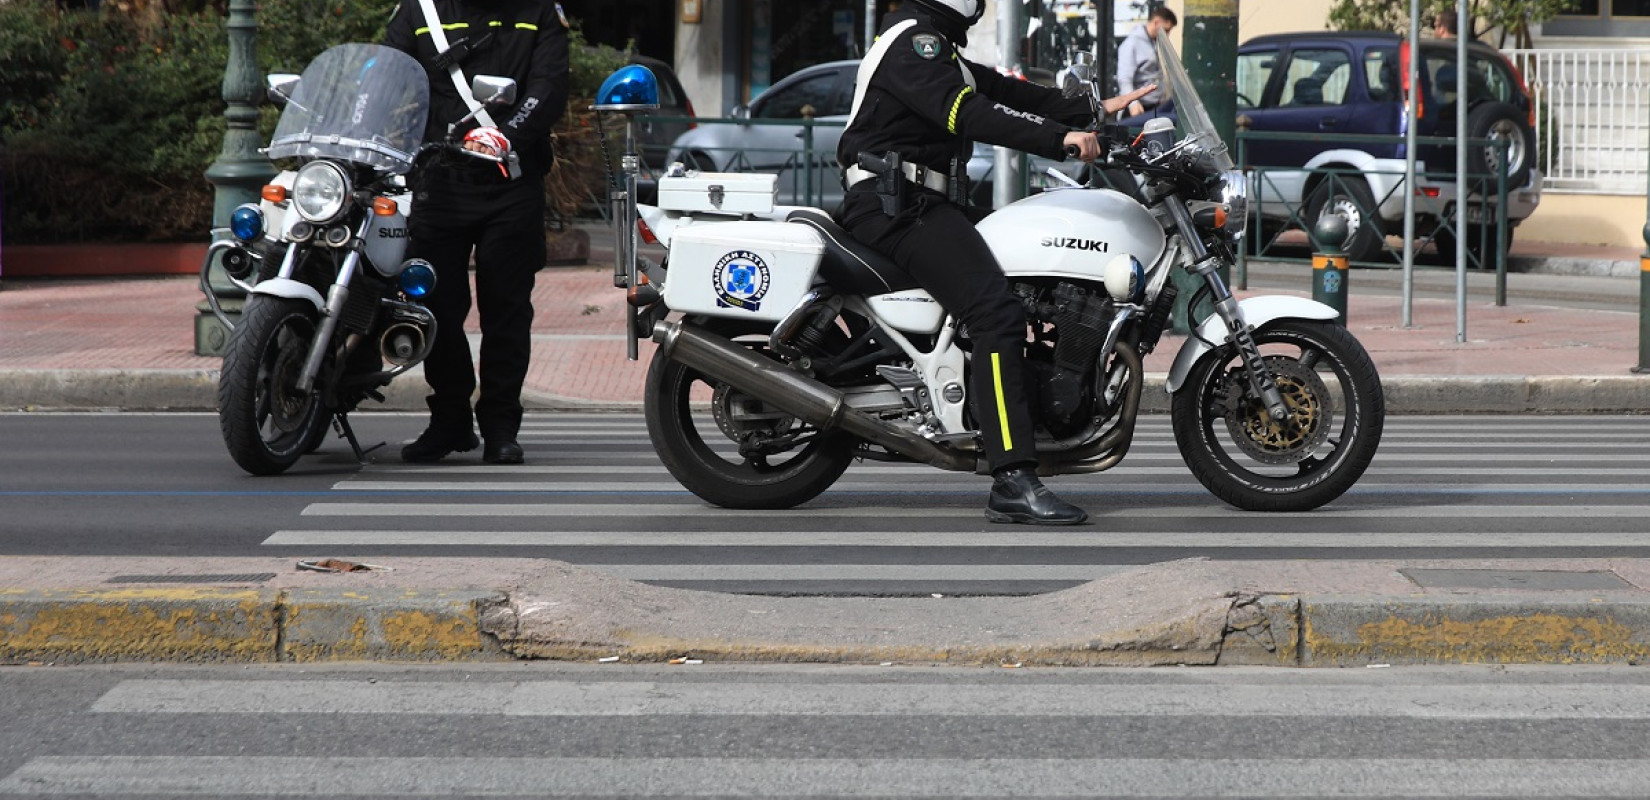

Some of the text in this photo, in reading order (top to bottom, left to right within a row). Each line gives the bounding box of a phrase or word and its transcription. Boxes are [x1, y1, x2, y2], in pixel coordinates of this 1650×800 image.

[507, 97, 540, 129] POLICE
[993, 103, 1046, 125] POLICE
[1041, 236, 1109, 254] SUZUKI
[1229, 318, 1274, 392] SUZUKI
